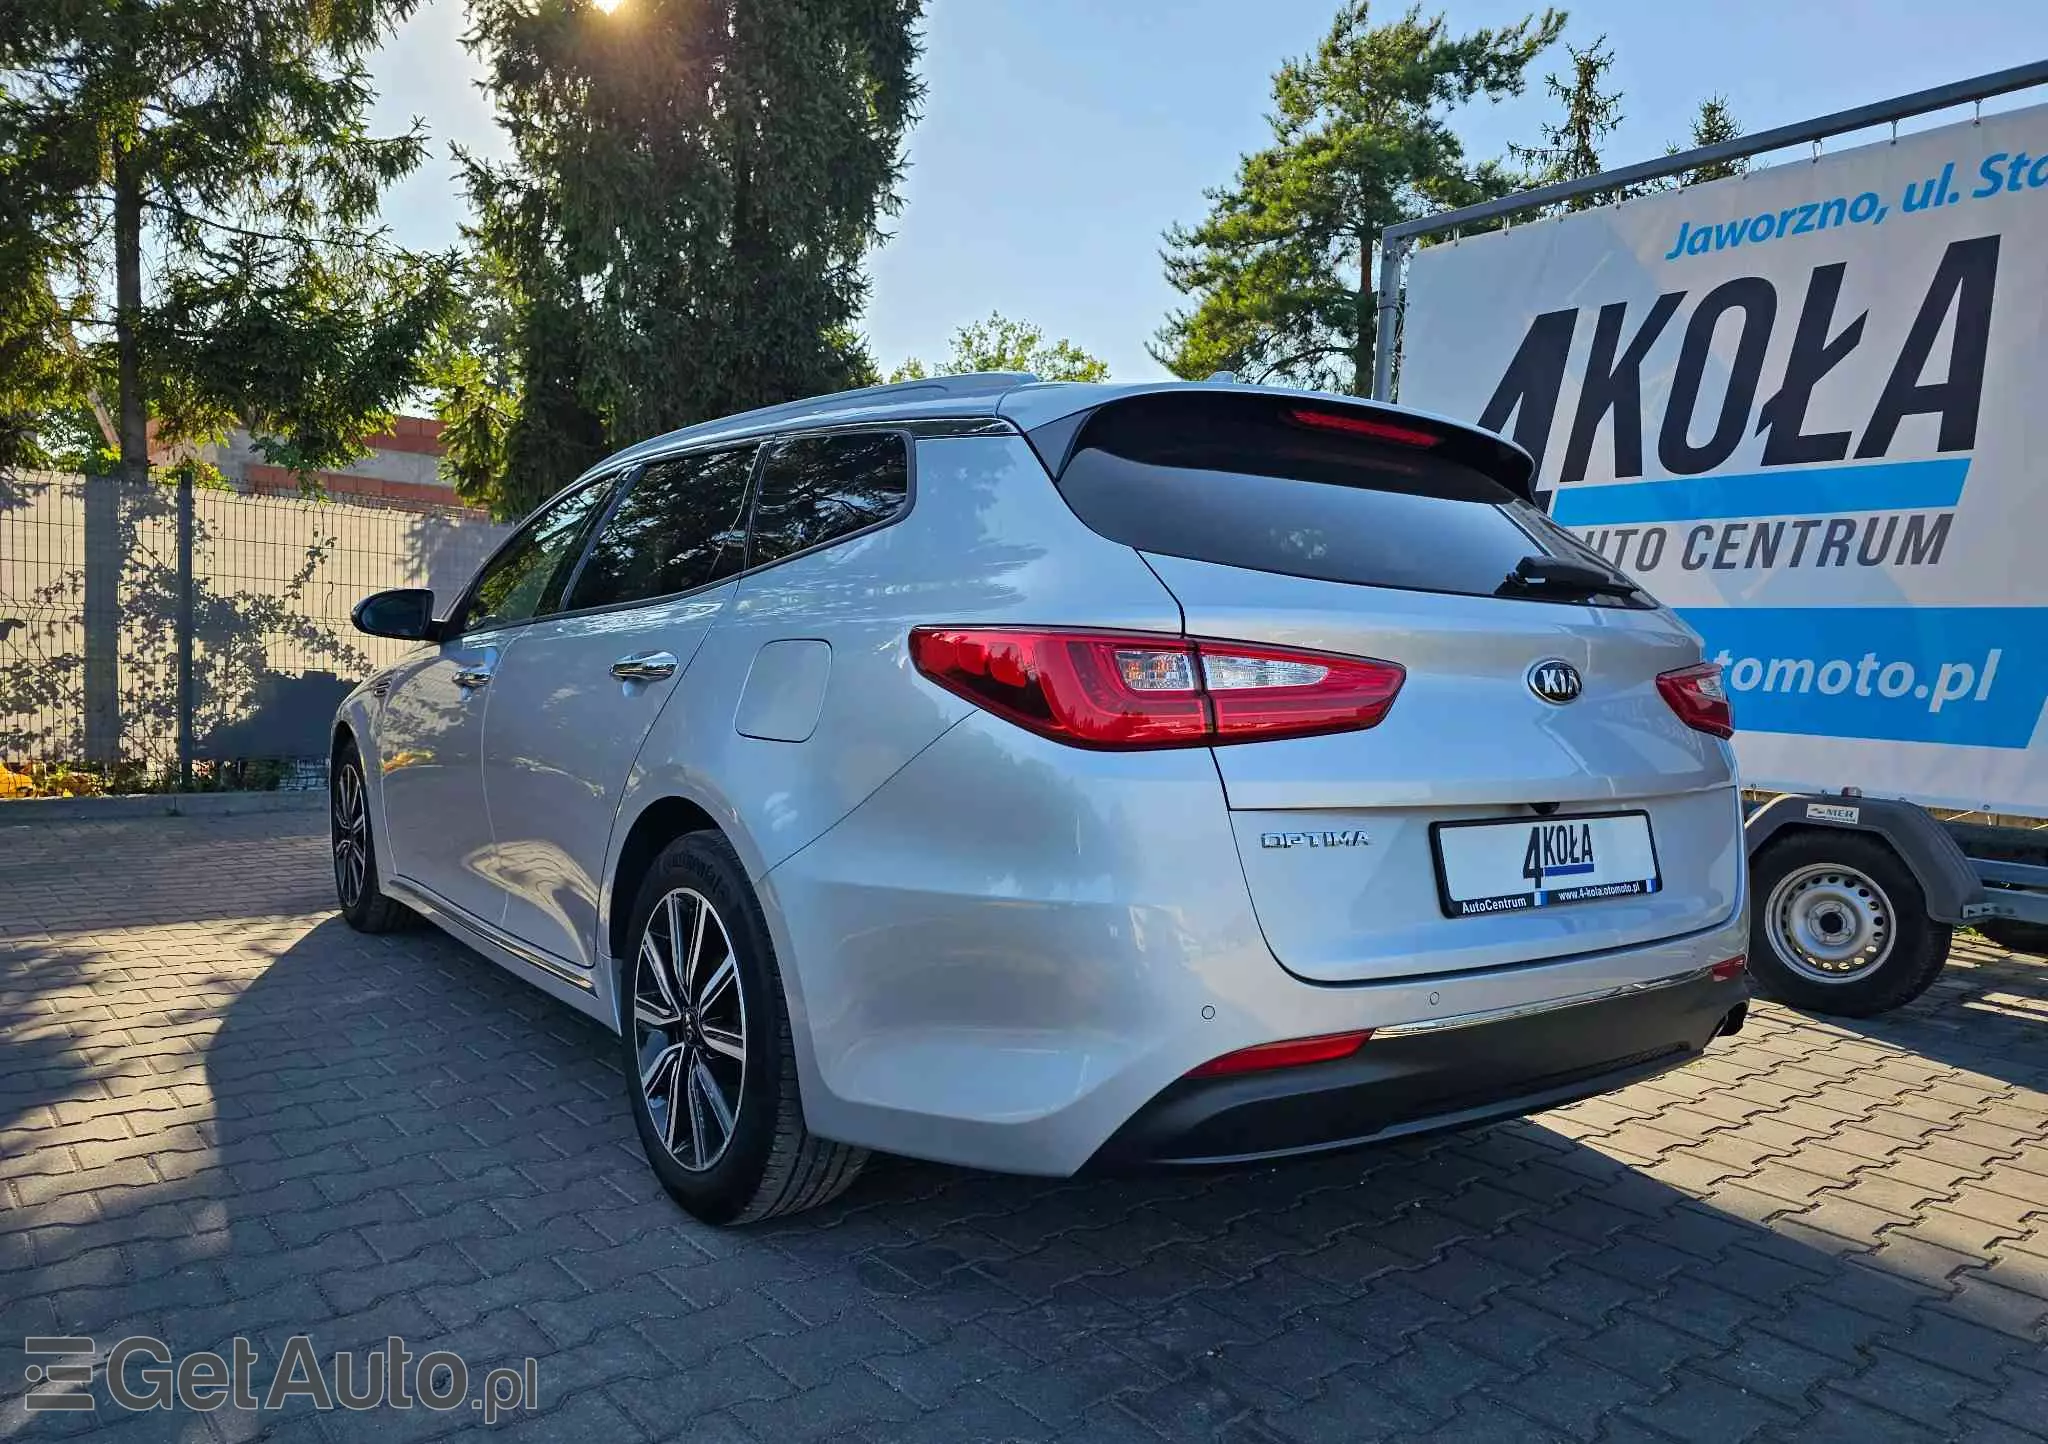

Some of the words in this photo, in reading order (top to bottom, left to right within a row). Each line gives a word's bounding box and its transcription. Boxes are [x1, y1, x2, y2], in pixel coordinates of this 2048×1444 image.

[1665, 191, 1889, 260] Jaworzno,
[1902, 162, 1959, 213] ul.
[1584, 527, 1667, 572] UTO
[1682, 513, 1954, 571] CENTRUM
[1541, 669, 1579, 694] KIA
[1261, 831, 1369, 848] OPTIMA
[1462, 896, 1527, 914] AutoCentrum
